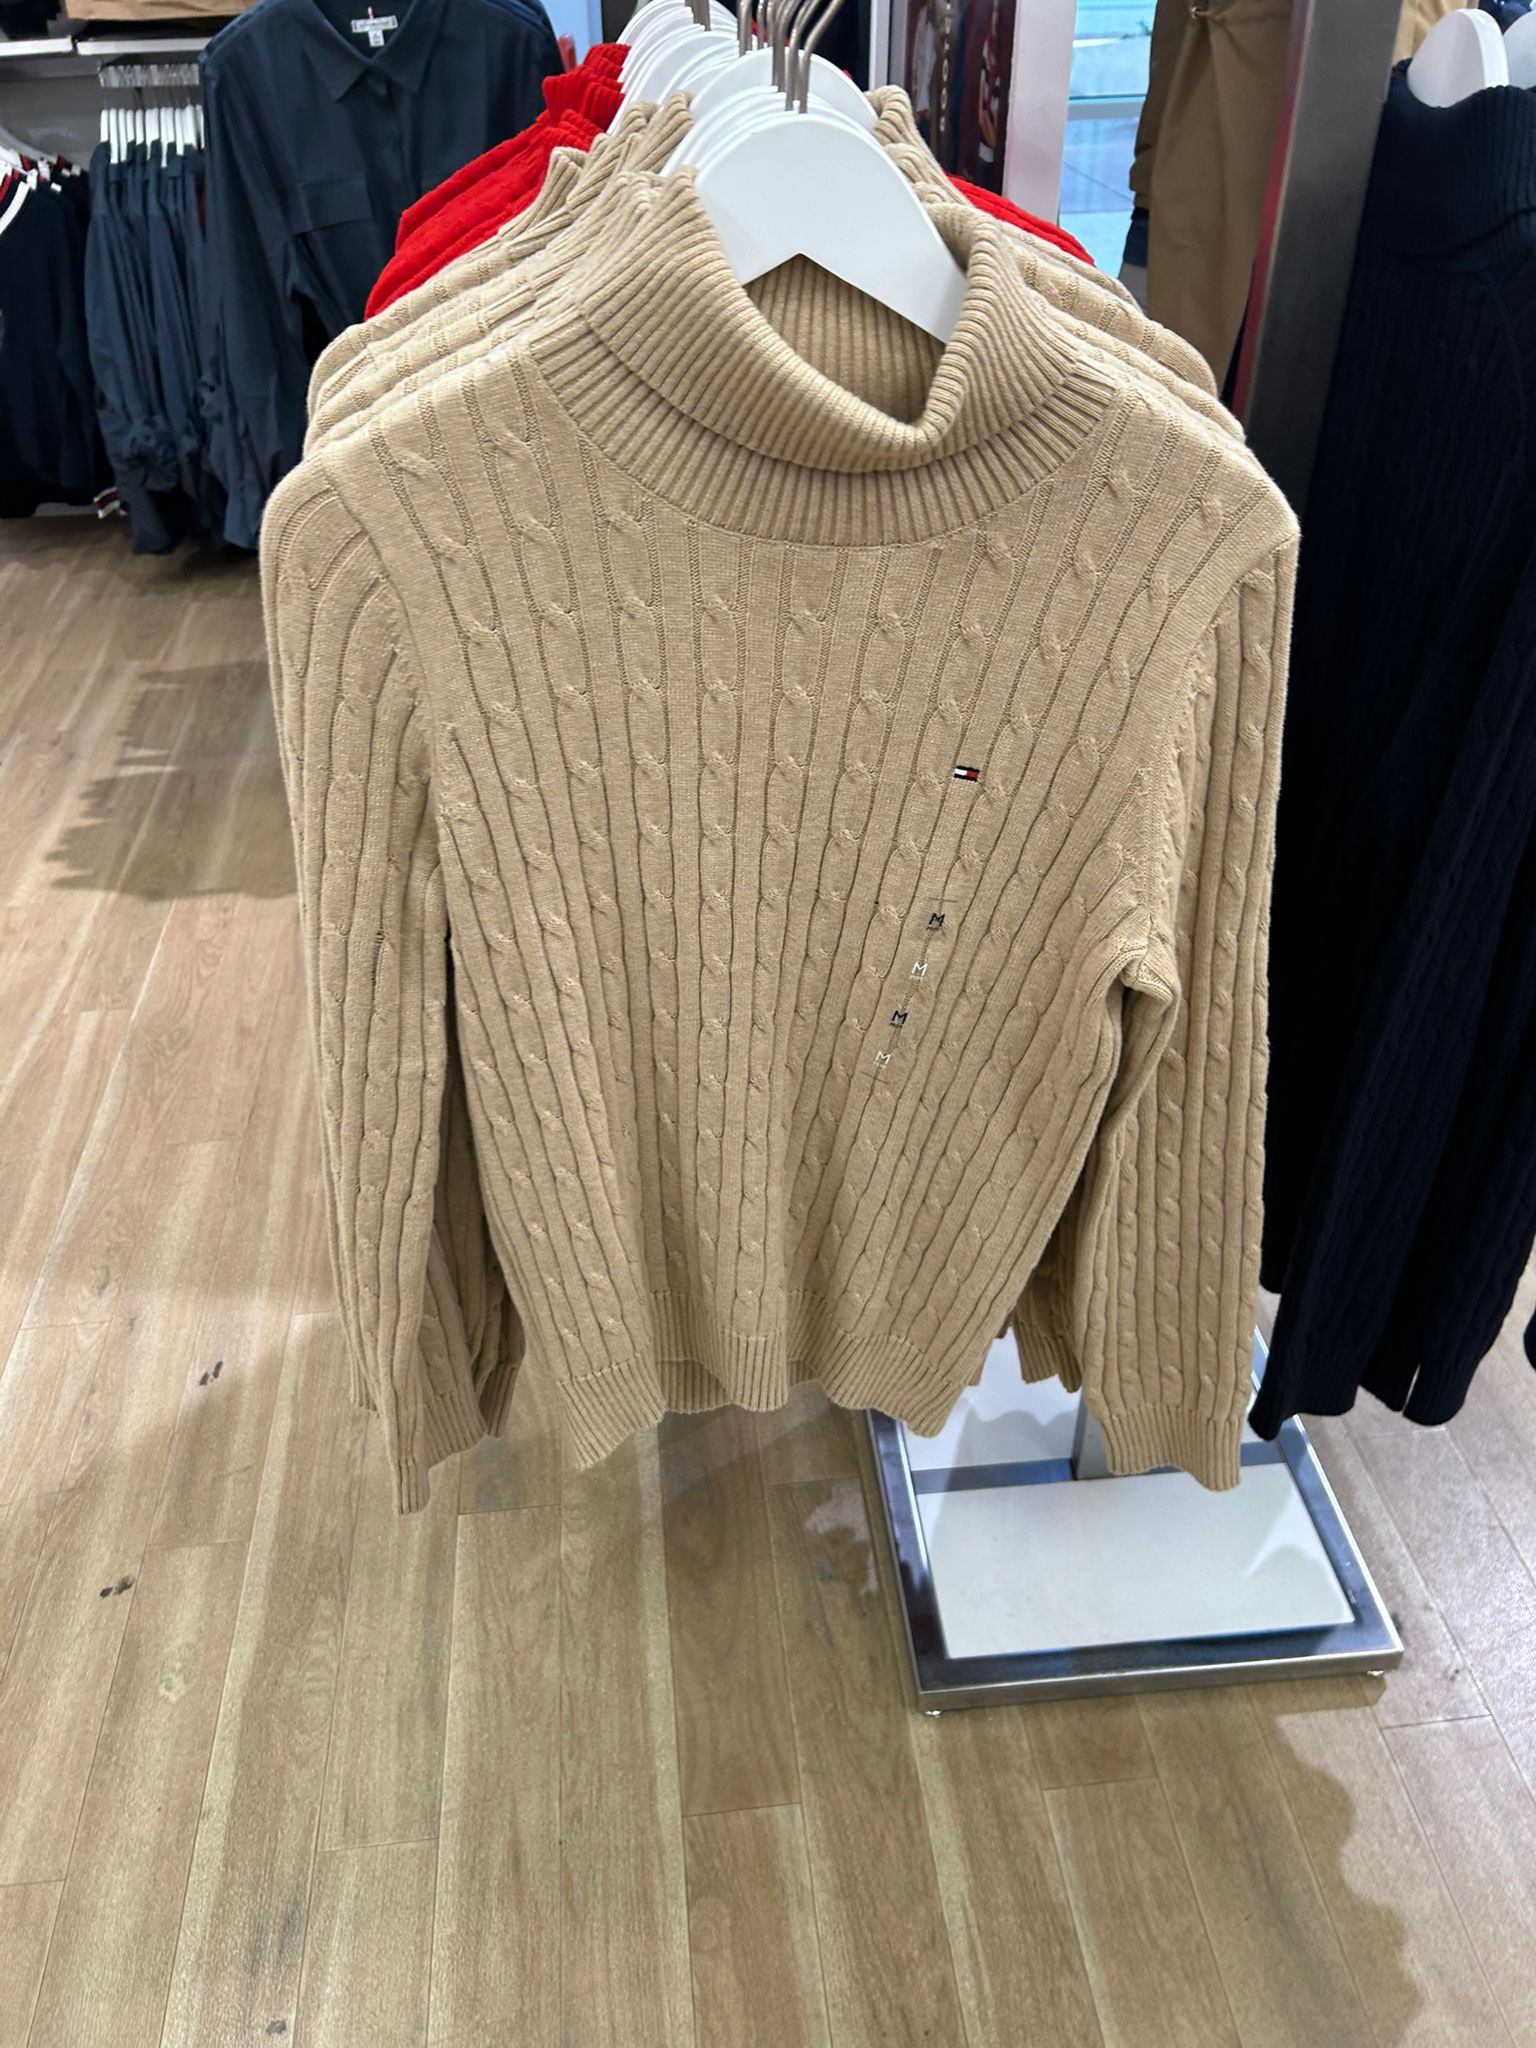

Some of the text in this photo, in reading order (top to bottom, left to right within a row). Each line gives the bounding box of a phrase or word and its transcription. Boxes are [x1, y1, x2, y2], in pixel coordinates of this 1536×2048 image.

[929, 912, 945, 927] M
[911, 961, 928, 976] M
[891, 1010, 908, 1025] M
[875, 1050, 891, 1065] M
